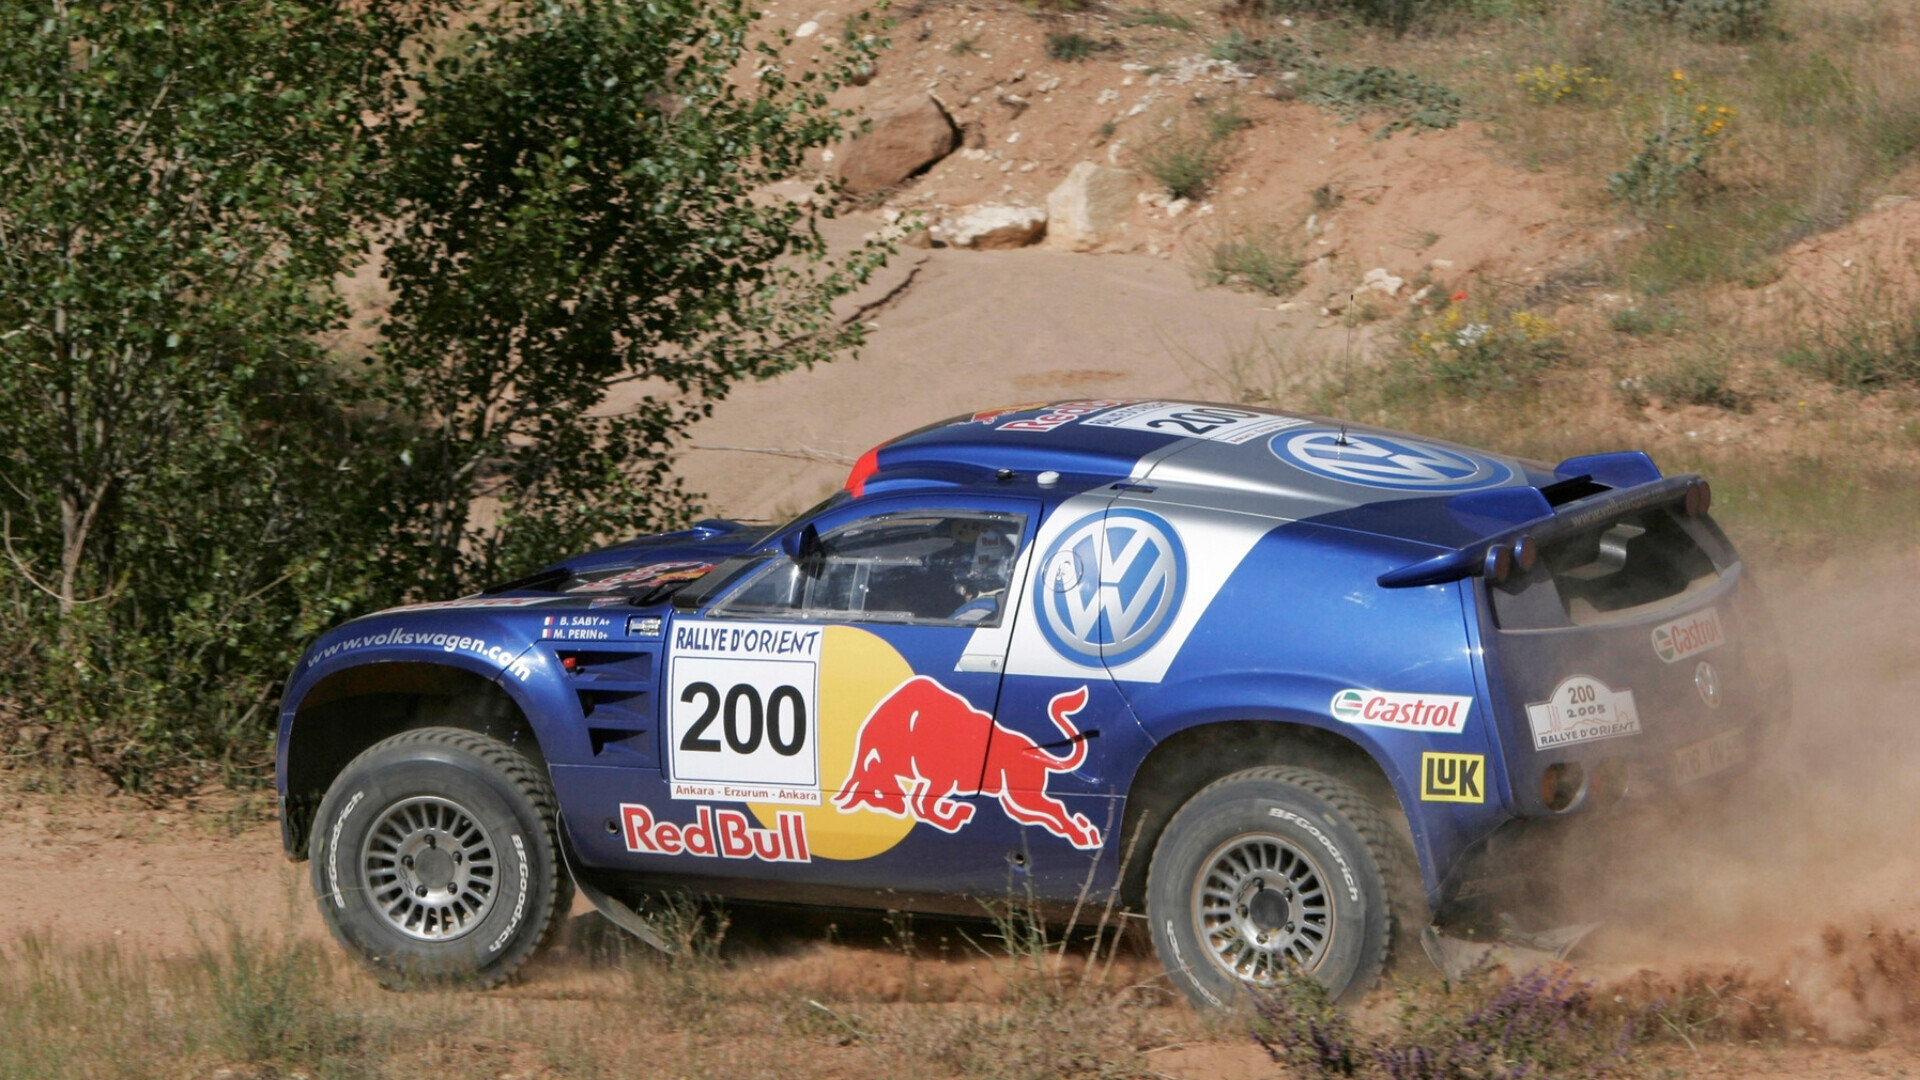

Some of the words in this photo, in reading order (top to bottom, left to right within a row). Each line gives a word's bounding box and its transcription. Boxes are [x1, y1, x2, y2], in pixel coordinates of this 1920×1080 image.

[1146, 408, 1259, 434] 200
[553, 629, 566, 639] M.
[568, 630, 597, 639] PERIN
[560, 617, 569, 626] B.
[571, 617, 599, 626] SABY
[1671, 615, 1721, 654] Castrol
[307, 627, 531, 682] www.volkswagen.com
[676, 627, 728, 651] RALLYE
[730, 629, 820, 655] D'ORIENT
[1568, 685, 1596, 704] 200
[680, 681, 807, 757] 200
[1363, 696, 1460, 727] Castrol
[1567, 704, 1606, 718] 2005
[1540, 730, 1578, 745] RALLYE
[1580, 721, 1635, 738] D'ORIENT
[676, 785, 715, 796] Ankara
[724, 787, 769, 798] Erzurum
[779, 789, 817, 801] Ankara
[622, 805, 717, 856] Red
[718, 811, 810, 862] Bull
[1269, 807, 1359, 902] BFGoodrich
[489, 834, 529, 952] BFGoodrich
